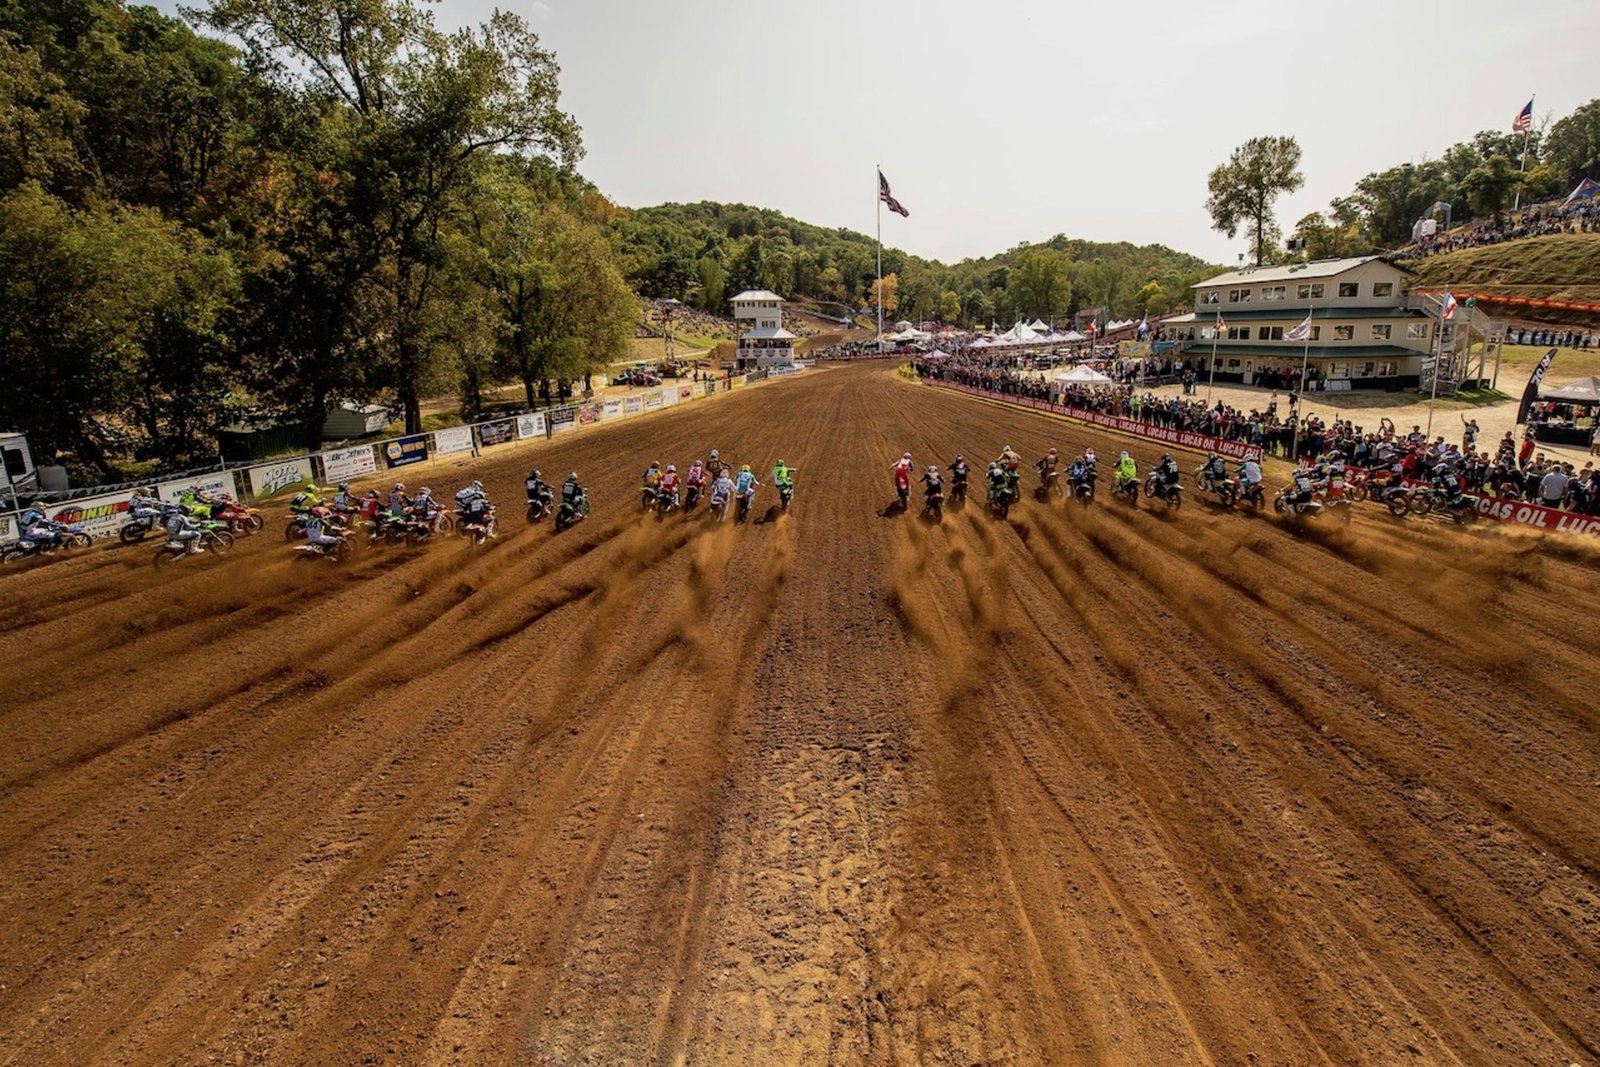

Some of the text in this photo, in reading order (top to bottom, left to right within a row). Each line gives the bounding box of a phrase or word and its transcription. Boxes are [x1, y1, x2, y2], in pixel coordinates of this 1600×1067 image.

[1118, 420, 1146, 434] LUCAS OIL
[1147, 426, 1179, 442] LUCAS OIL
[1180, 433, 1216, 451] LUCAS OIL
[1218, 440, 1260, 461] LUCAS OIL
[262, 464, 298, 489] MOTO
[270, 473, 302, 496] TEES
[1516, 507, 1547, 528] OIL
